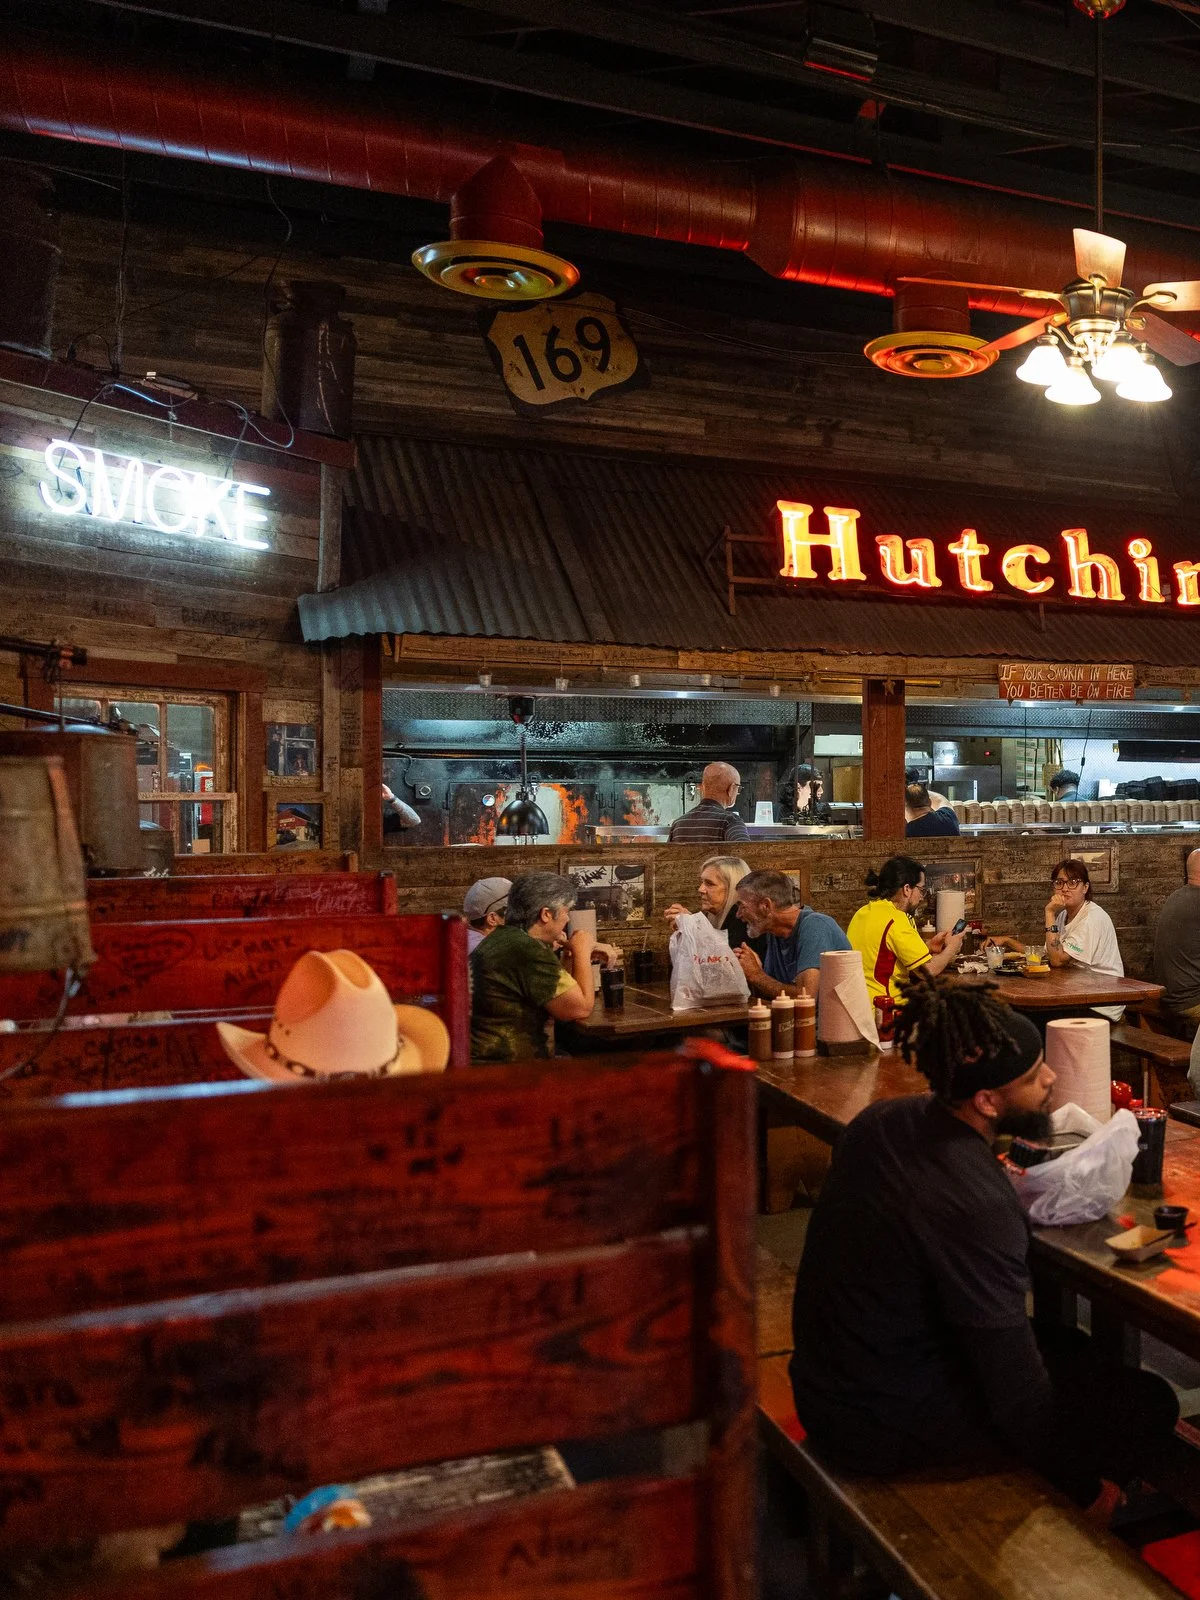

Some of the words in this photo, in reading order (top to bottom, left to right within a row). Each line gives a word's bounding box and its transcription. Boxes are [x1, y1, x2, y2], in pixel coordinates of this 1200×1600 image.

[513, 316, 611, 391] 169
[38, 438, 271, 550] SMOKE
[1000, 664, 1017, 681] IF
[1022, 664, 1043, 681] YOUR
[1047, 664, 1084, 681] SMOKIN
[1090, 665, 1100, 681] IN
[1107, 664, 1134, 681] HERE
[1003, 681, 1025, 698] YOU
[1029, 681, 1065, 699] BETTER
[1070, 682, 1083, 698] BE
[1087, 682, 1100, 698] ON
